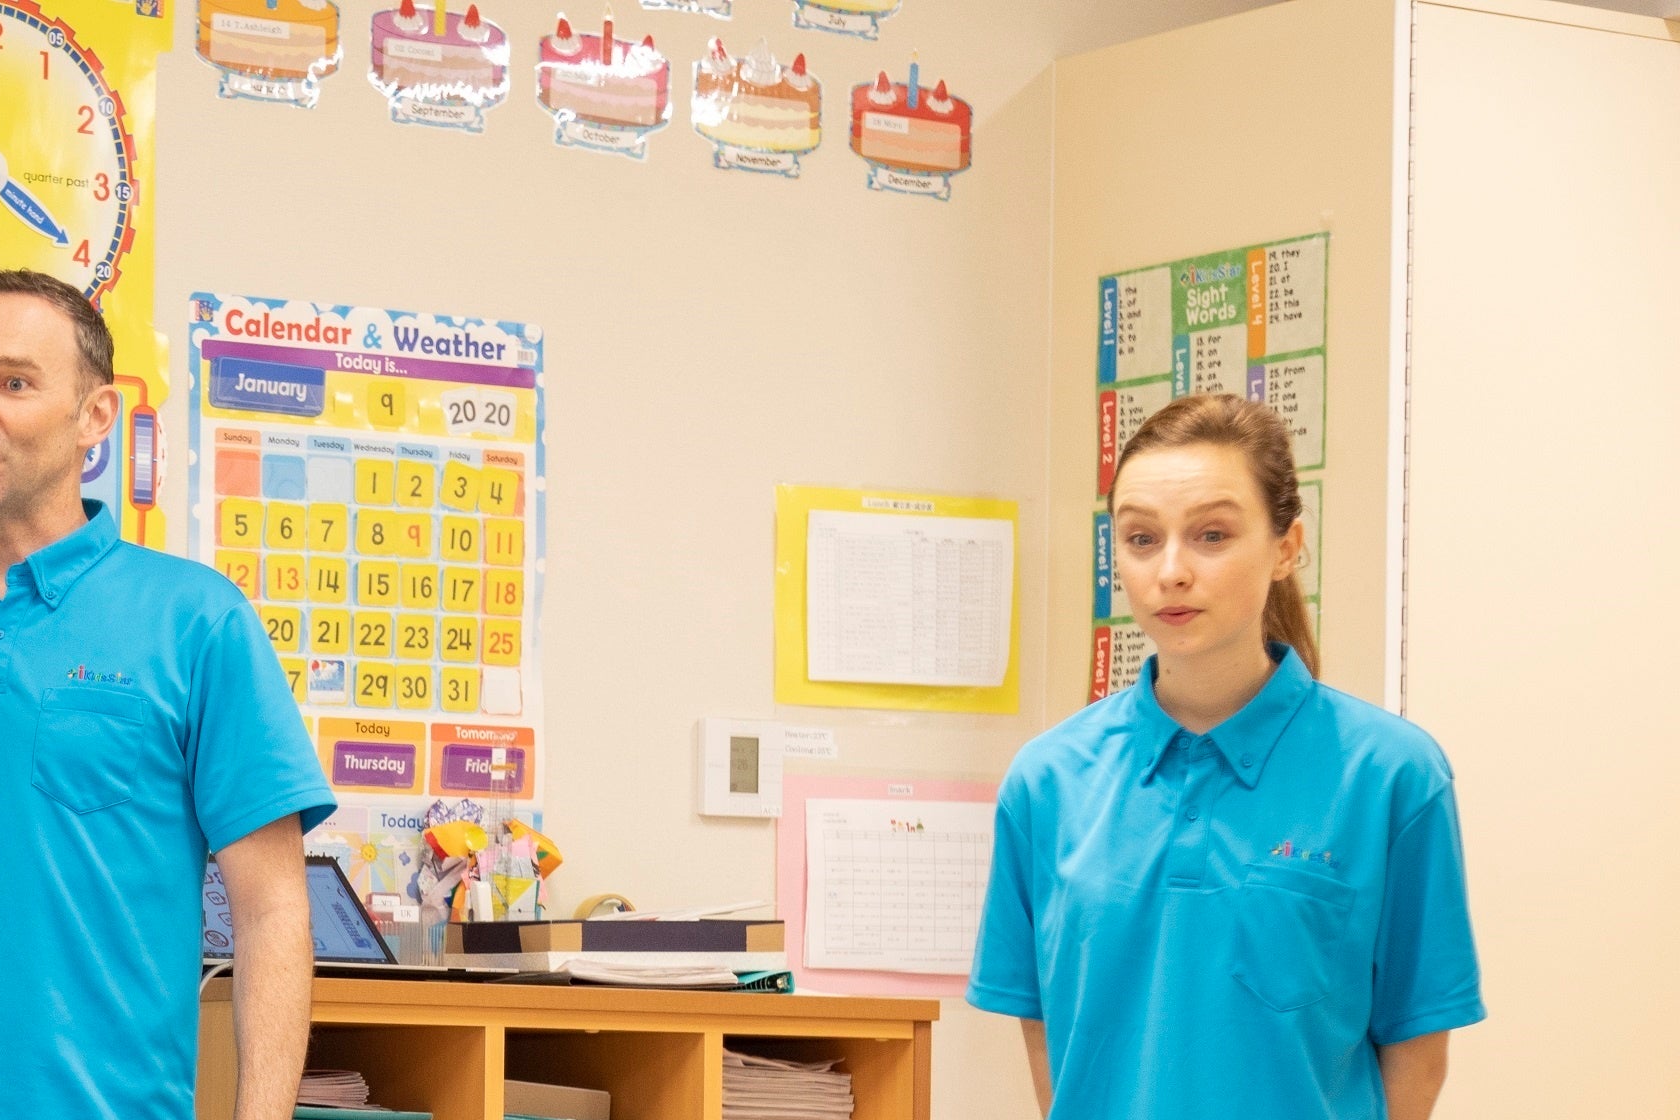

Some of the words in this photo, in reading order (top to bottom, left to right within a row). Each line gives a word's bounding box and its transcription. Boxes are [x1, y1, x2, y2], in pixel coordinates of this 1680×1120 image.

[828, 14, 847, 28] July
[77, 105, 95, 135] 2
[411, 104, 465, 119] September
[583, 129, 620, 144] October
[736, 153, 782, 168] November
[23, 171, 64, 187] quarter
[66, 176, 90, 192] past
[93, 173, 111, 201] 3
[887, 174, 932, 189] December
[72, 239, 91, 268] 4
[95, 265, 111, 278] 20
[1251, 261, 1263, 309] Level
[1187, 284, 1228, 308] Sight
[1103, 287, 1115, 335] Level
[1186, 303, 1237, 326] Words
[225, 309, 352, 345] Calendar
[362, 323, 382, 350] &
[393, 325, 507, 361] Weather
[336, 353, 382, 374] Today
[235, 373, 308, 402] January
[449, 400, 477, 426] 20
[484, 402, 511, 427] 20
[1102, 400, 1114, 443] Level
[224, 432, 253, 445] Sunday
[268, 435, 300, 449] Monday
[313, 439, 346, 453] Tuesday
[353, 443, 396, 456] Wednesday
[400, 446, 433, 459] Thursday
[485, 452, 519, 466] Saturday
[410, 475, 423, 498] 2
[453, 476, 468, 499] 3
[234, 514, 248, 537] 5
[280, 517, 293, 540] 6
[321, 520, 334, 543] 7
[372, 522, 385, 546] 8
[450, 528, 473, 552] 10
[1098, 524, 1109, 571] Level
[277, 567, 300, 590] 13
[318, 569, 340, 593] 14
[368, 573, 390, 596] 15
[411, 574, 433, 598] 16
[451, 578, 475, 602] 17
[495, 582, 517, 605] 18
[266, 619, 294, 642] 20
[318, 620, 341, 644] 21
[360, 623, 387, 647] 22
[404, 626, 430, 649] 23
[447, 628, 472, 651] 24
[488, 631, 514, 655] 25
[1095, 637, 1108, 684] Level
[361, 673, 388, 698] 29
[402, 676, 427, 699] 30
[448, 679, 469, 703] 31
[355, 722, 390, 737] Today
[344, 754, 406, 775] Thursday
